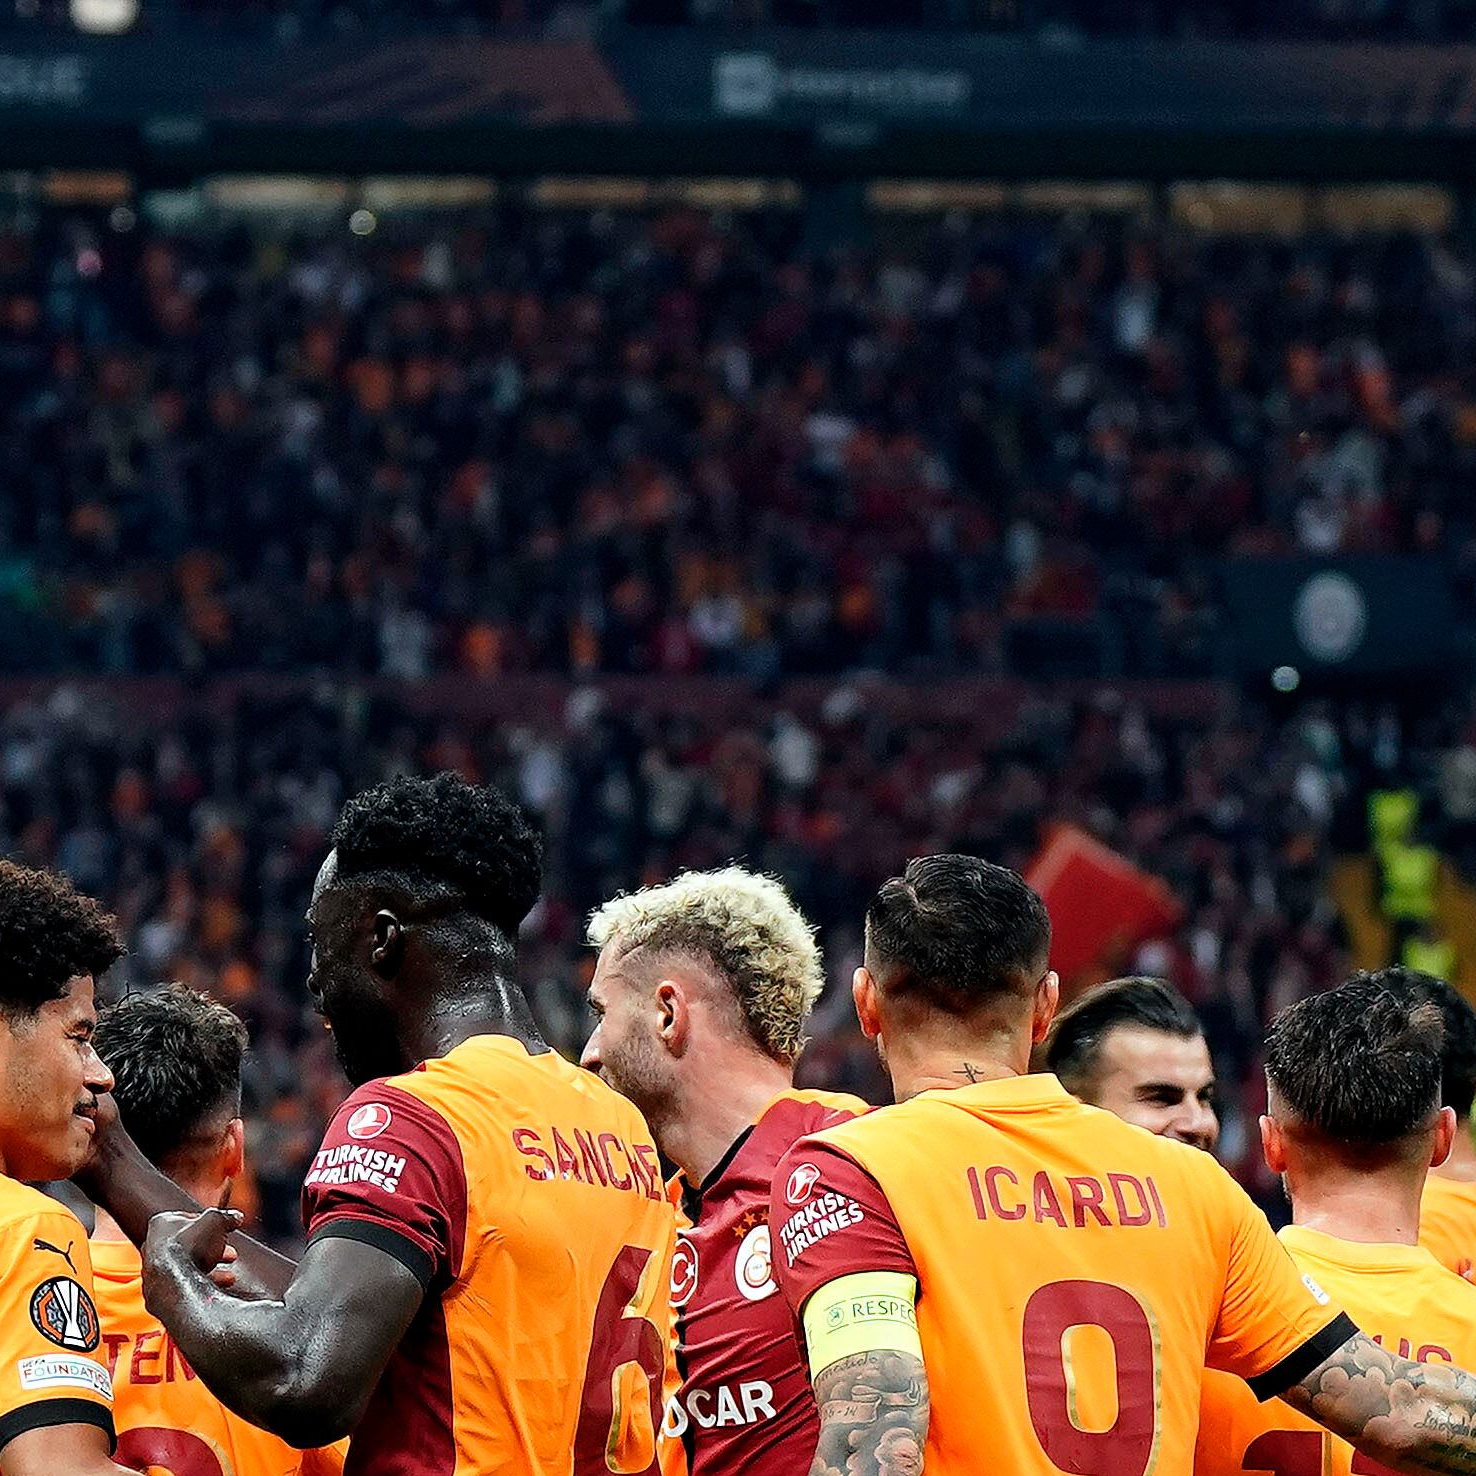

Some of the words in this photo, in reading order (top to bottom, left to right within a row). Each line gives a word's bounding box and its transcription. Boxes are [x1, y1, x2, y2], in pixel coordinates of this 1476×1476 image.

[304, 1162, 399, 1194] AIRLINES
[314, 1144, 406, 1177] TURKISH
[966, 1166, 1168, 1229] ICARDI
[785, 1202, 864, 1268] AIRLINES
[852, 1299, 916, 1325] RESPEC
[661, 1380, 777, 1438] OCAR
